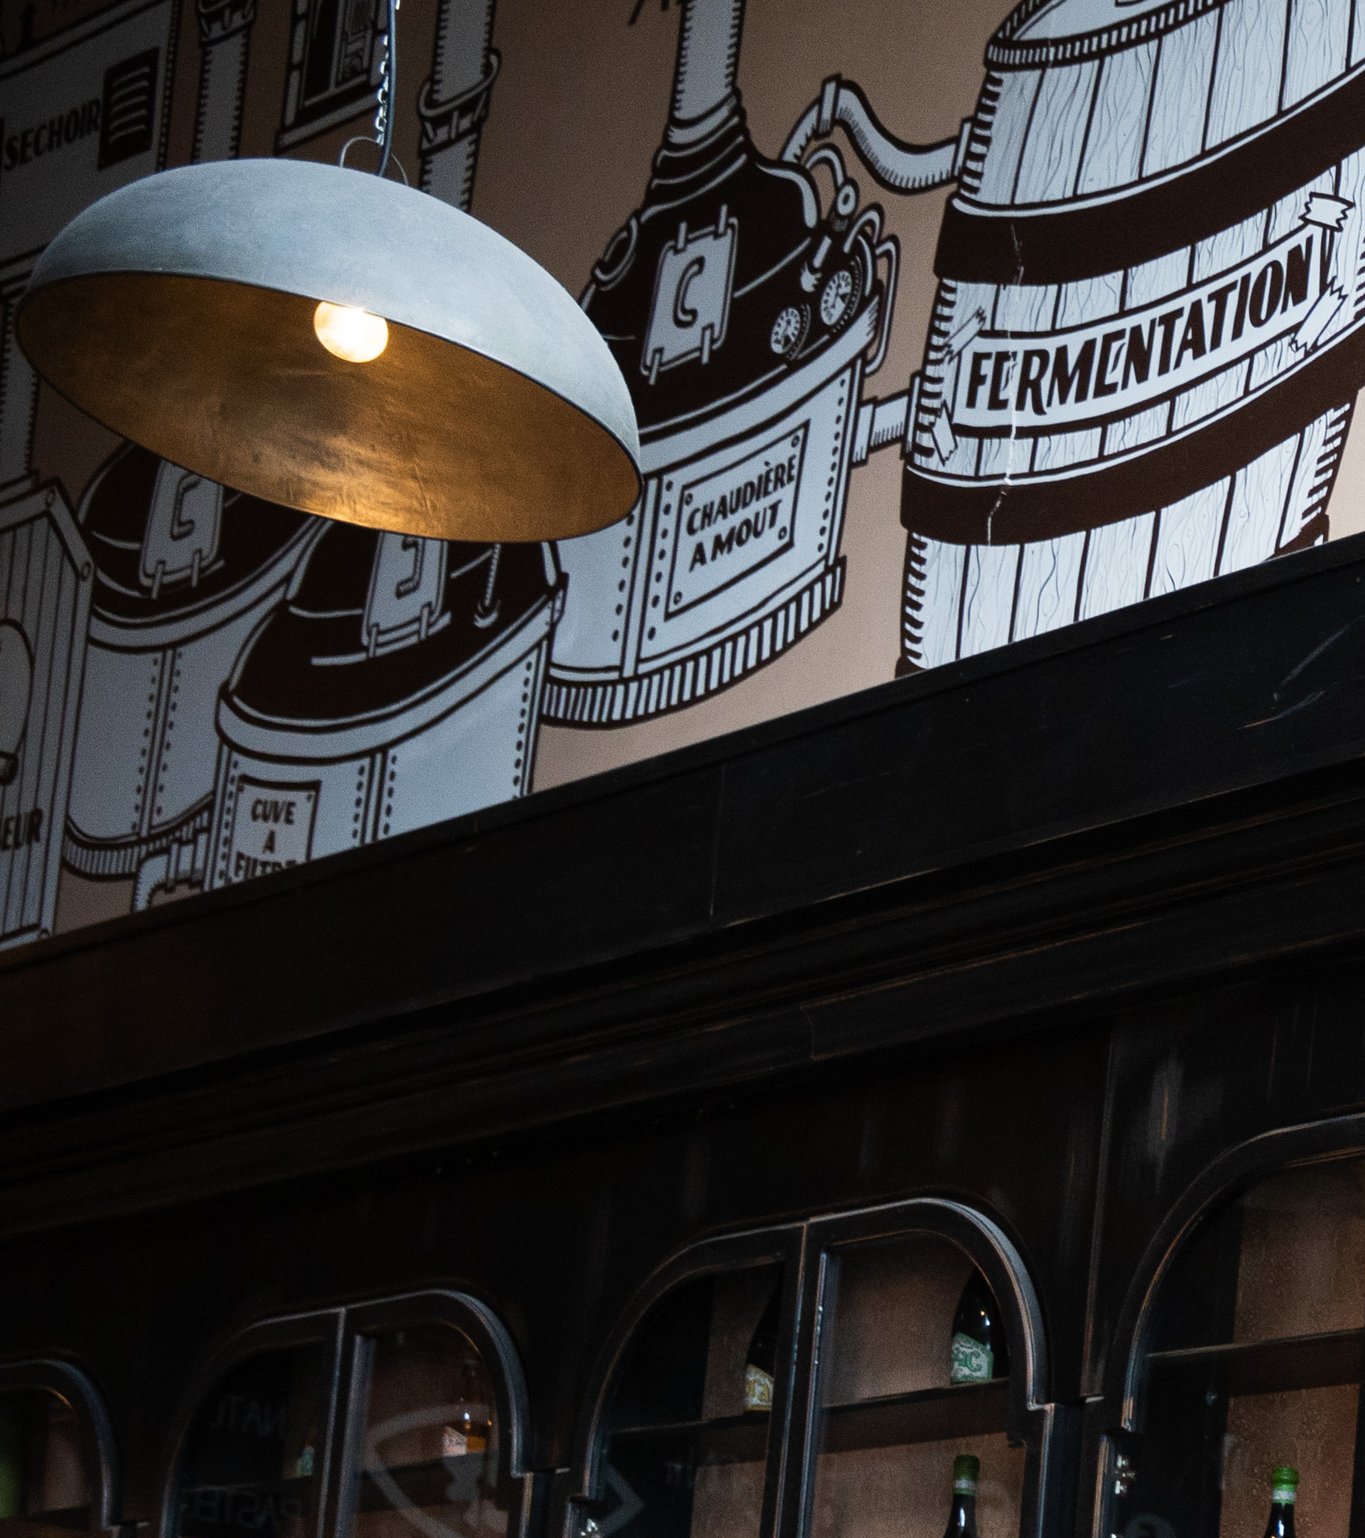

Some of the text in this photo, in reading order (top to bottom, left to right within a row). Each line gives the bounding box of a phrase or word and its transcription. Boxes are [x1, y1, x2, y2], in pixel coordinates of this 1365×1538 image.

[3, 98, 101, 171] SECHOIR
[965, 236, 1322, 416] FERMENTATION
[686, 454, 797, 536] CHAUDIÈRE
[711, 500, 783, 557] MOUT
[250, 799, 297, 825] CUVE
[262, 830, 276, 855] A
